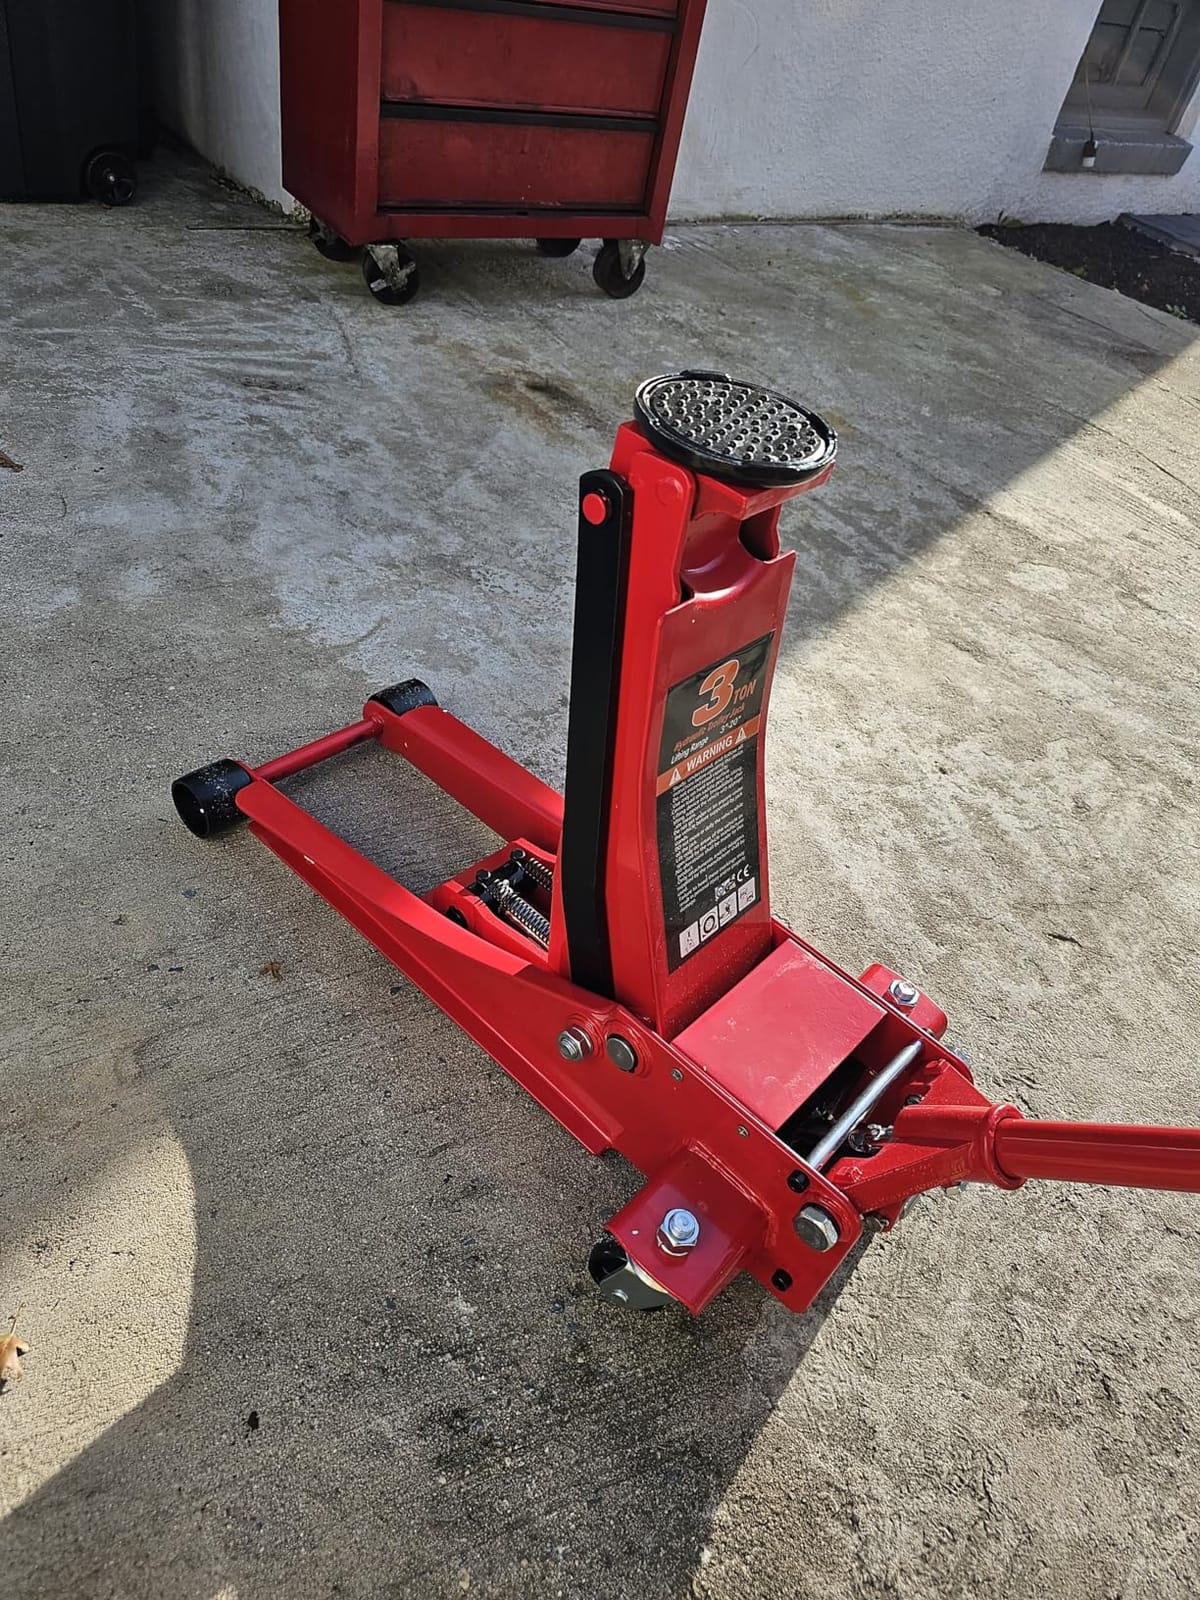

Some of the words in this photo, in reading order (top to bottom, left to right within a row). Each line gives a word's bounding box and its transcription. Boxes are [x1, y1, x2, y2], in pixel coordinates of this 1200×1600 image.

[691, 659, 739, 727] 3
[733, 679, 757, 705] TON
[686, 735, 733, 772] WARNING
[690, 736, 709, 753] Range
